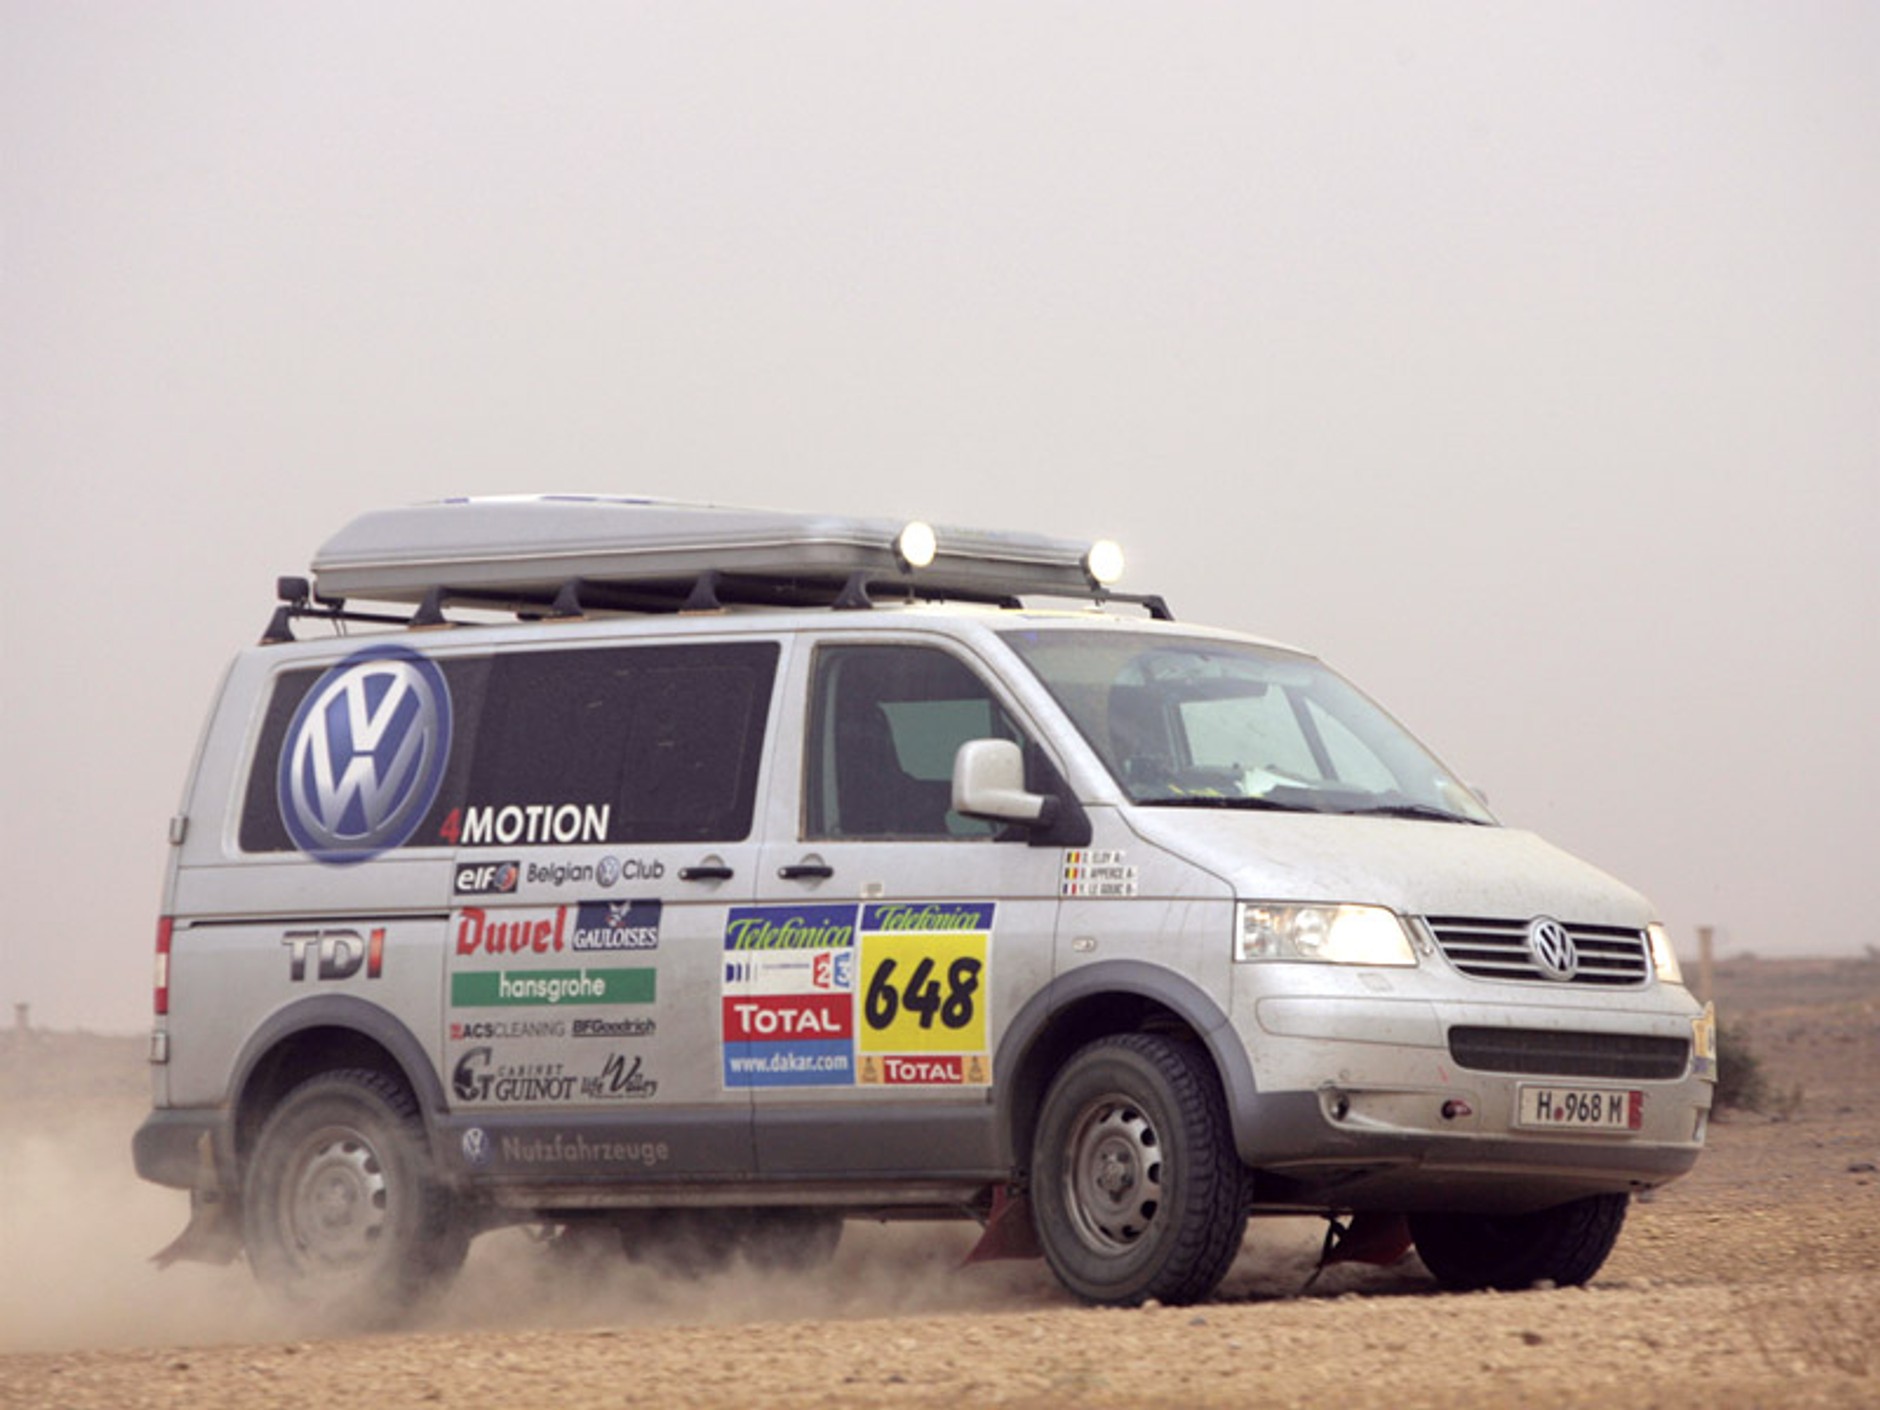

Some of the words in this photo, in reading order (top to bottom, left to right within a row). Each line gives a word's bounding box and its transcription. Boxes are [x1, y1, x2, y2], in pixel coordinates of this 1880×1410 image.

[440, 804, 611, 845] 4MOTION
[455, 864, 498, 891] elf
[526, 863, 594, 883] Belgian
[622, 856, 665, 880] Club
[455, 904, 568, 955] Duvel
[573, 928, 657, 949] GAULOISES
[281, 928, 386, 982] TDI
[499, 969, 605, 1002] hansgrohe
[865, 957, 982, 1030] 648
[572, 1019, 656, 1037] BFGoodrich
[729, 1053, 848, 1073] www.dakar.com
[496, 1077, 576, 1101] GUINOT
[1608, 1095, 1622, 1123] M
[501, 1134, 670, 1166] Nutzfahrzeuge
